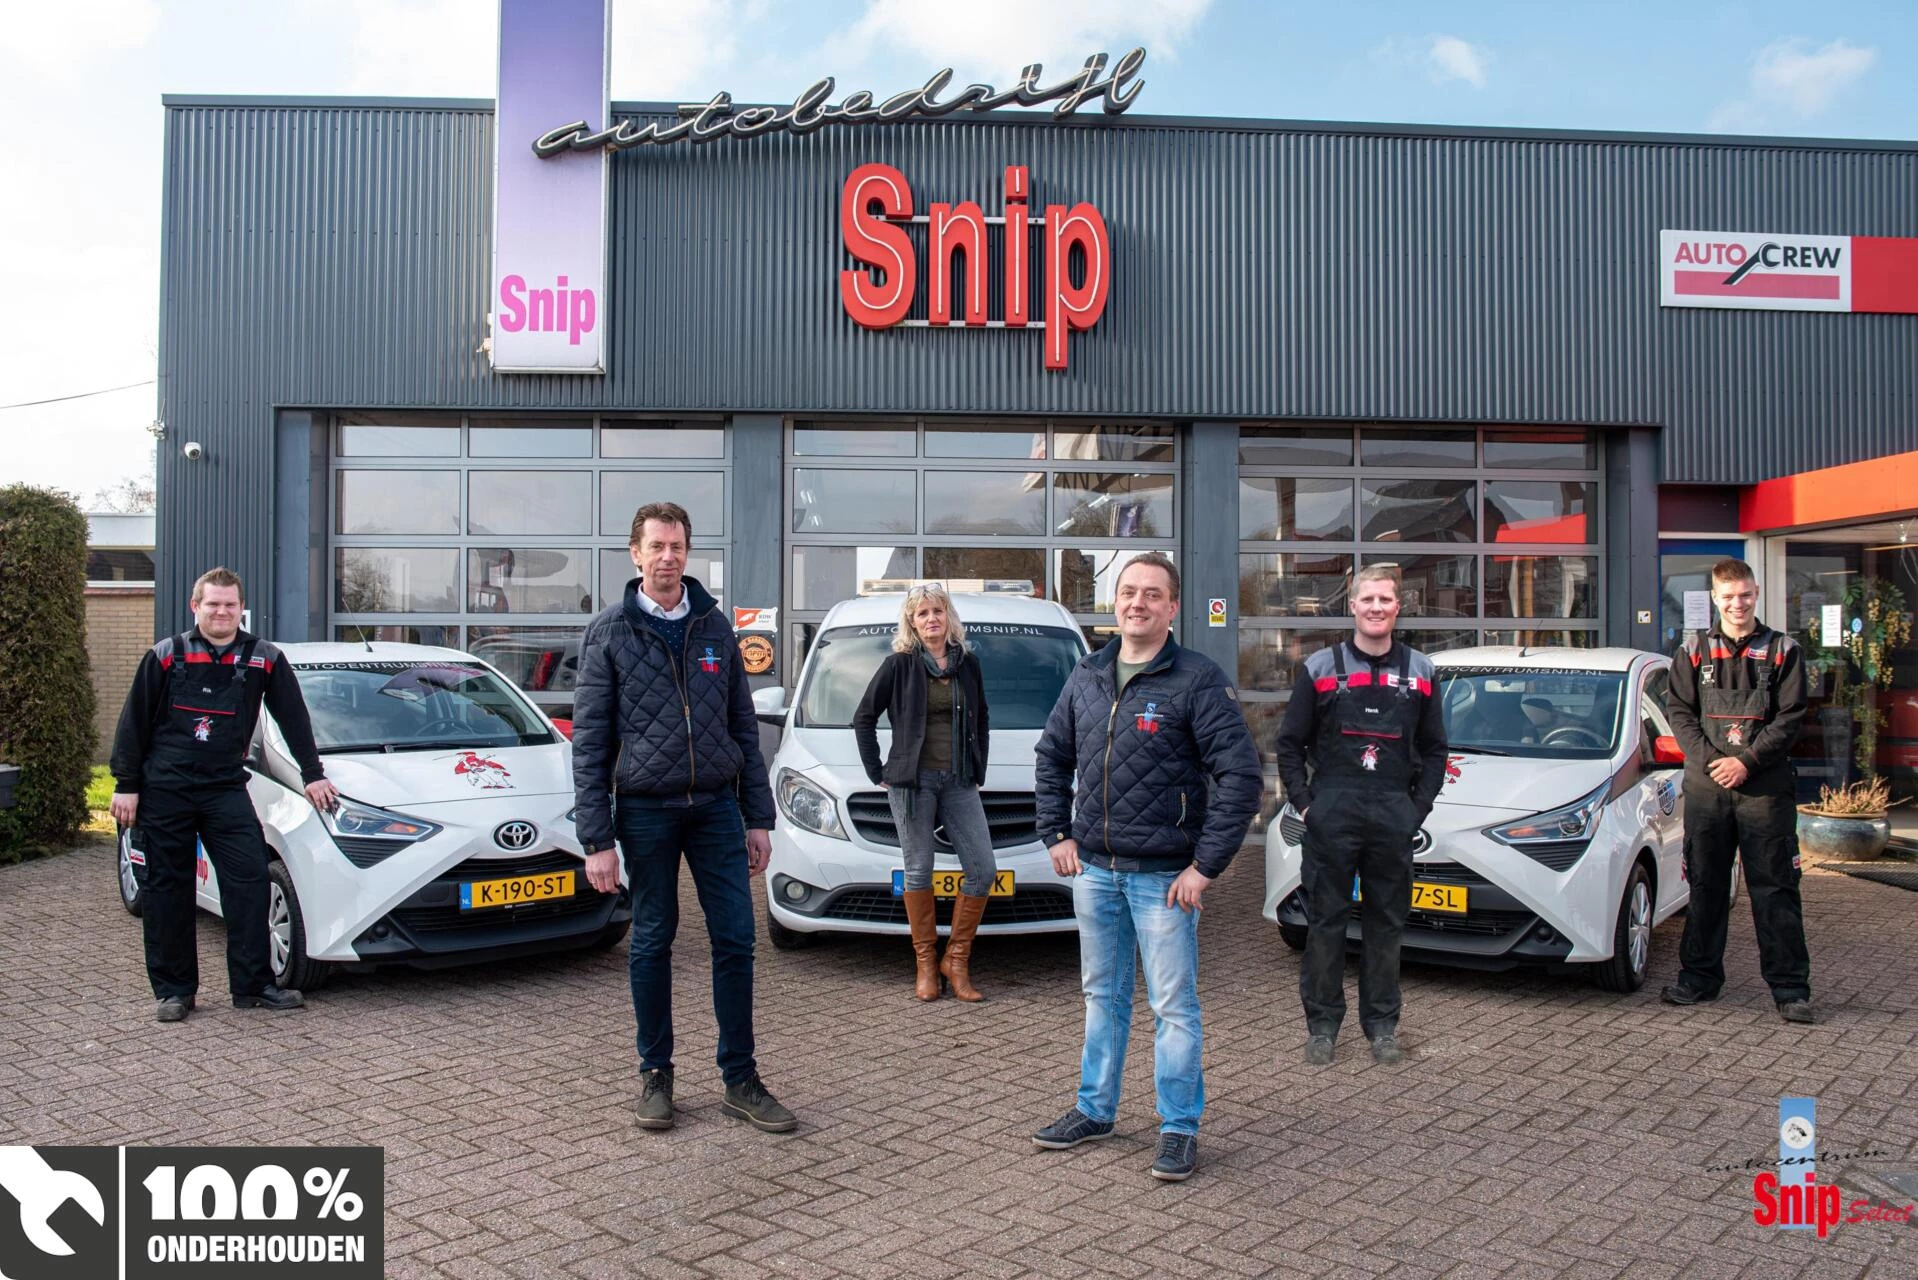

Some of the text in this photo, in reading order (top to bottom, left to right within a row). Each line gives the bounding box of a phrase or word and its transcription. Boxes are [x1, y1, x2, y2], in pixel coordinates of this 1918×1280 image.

[841, 163, 1110, 371] Snip
[1674, 242, 1841, 269] AUTO CREW
[499, 274, 596, 345] Snip
[482, 876, 566, 903] K-190-ST
